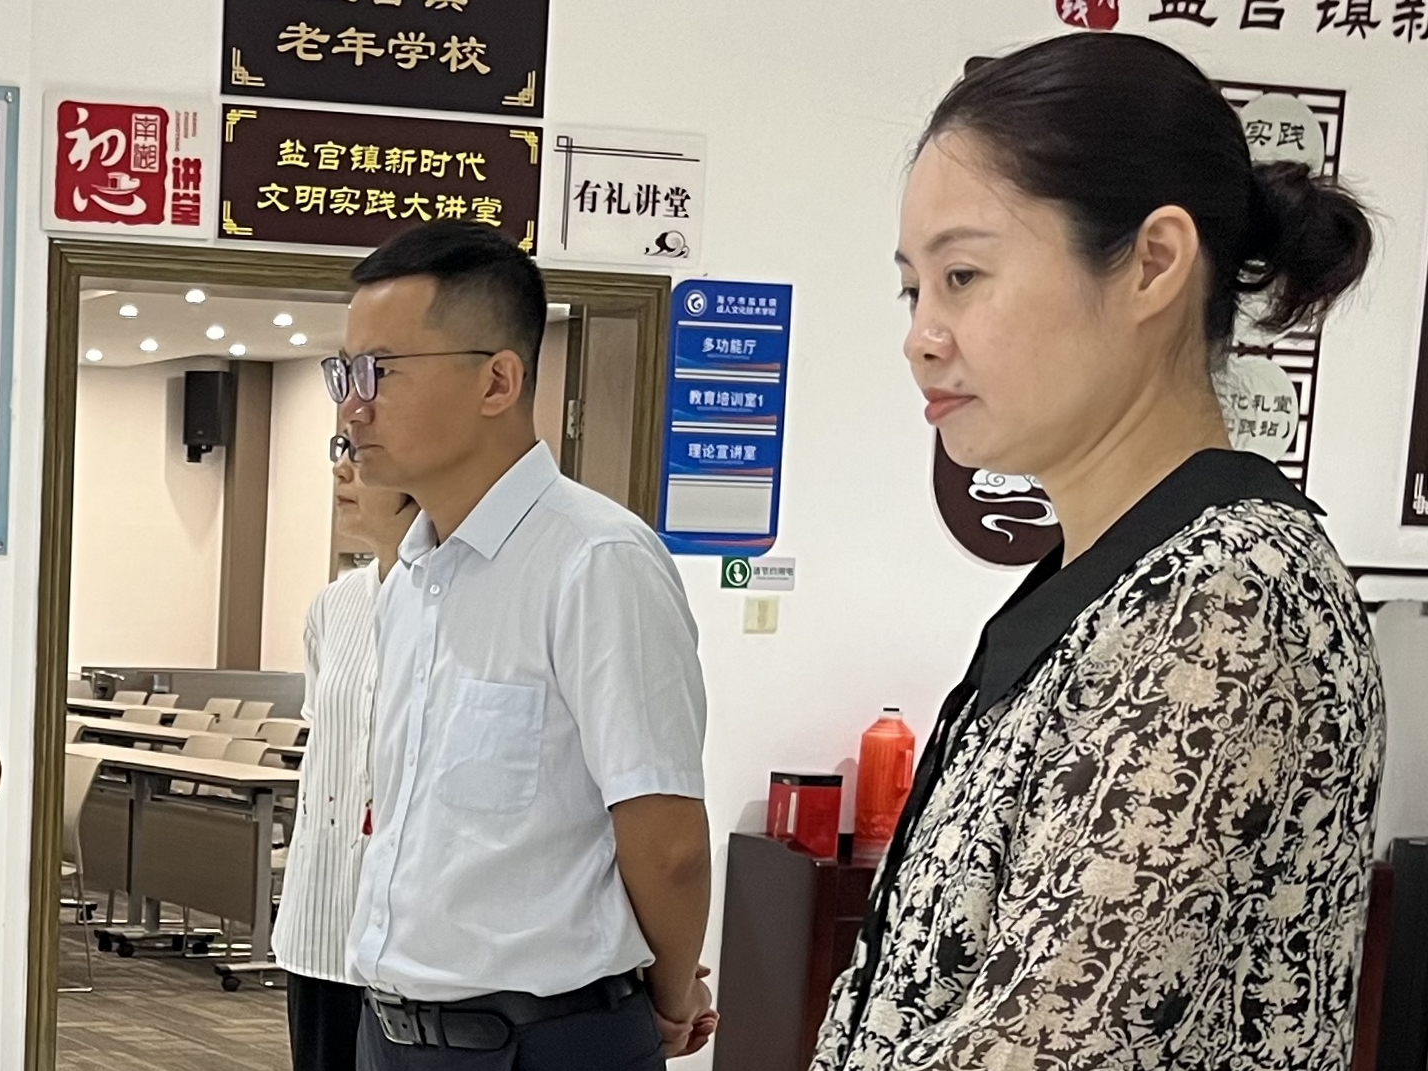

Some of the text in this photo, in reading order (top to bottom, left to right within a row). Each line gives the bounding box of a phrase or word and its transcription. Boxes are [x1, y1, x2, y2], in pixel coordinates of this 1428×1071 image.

[276, 21, 492, 75] 老年学校
[64, 107, 148, 216] 初心
[277, 139, 487, 182] 盐官镇新时代
[172, 157, 202, 226] 讲堂
[258, 183, 504, 228] 文明实践大讲堂
[572, 179, 692, 221] 有礼讲堂
[702, 337, 757, 356] 多功能厅
[689, 389, 764, 408] 教育培训室1
[688, 442, 757, 461] 理论宣讲室
